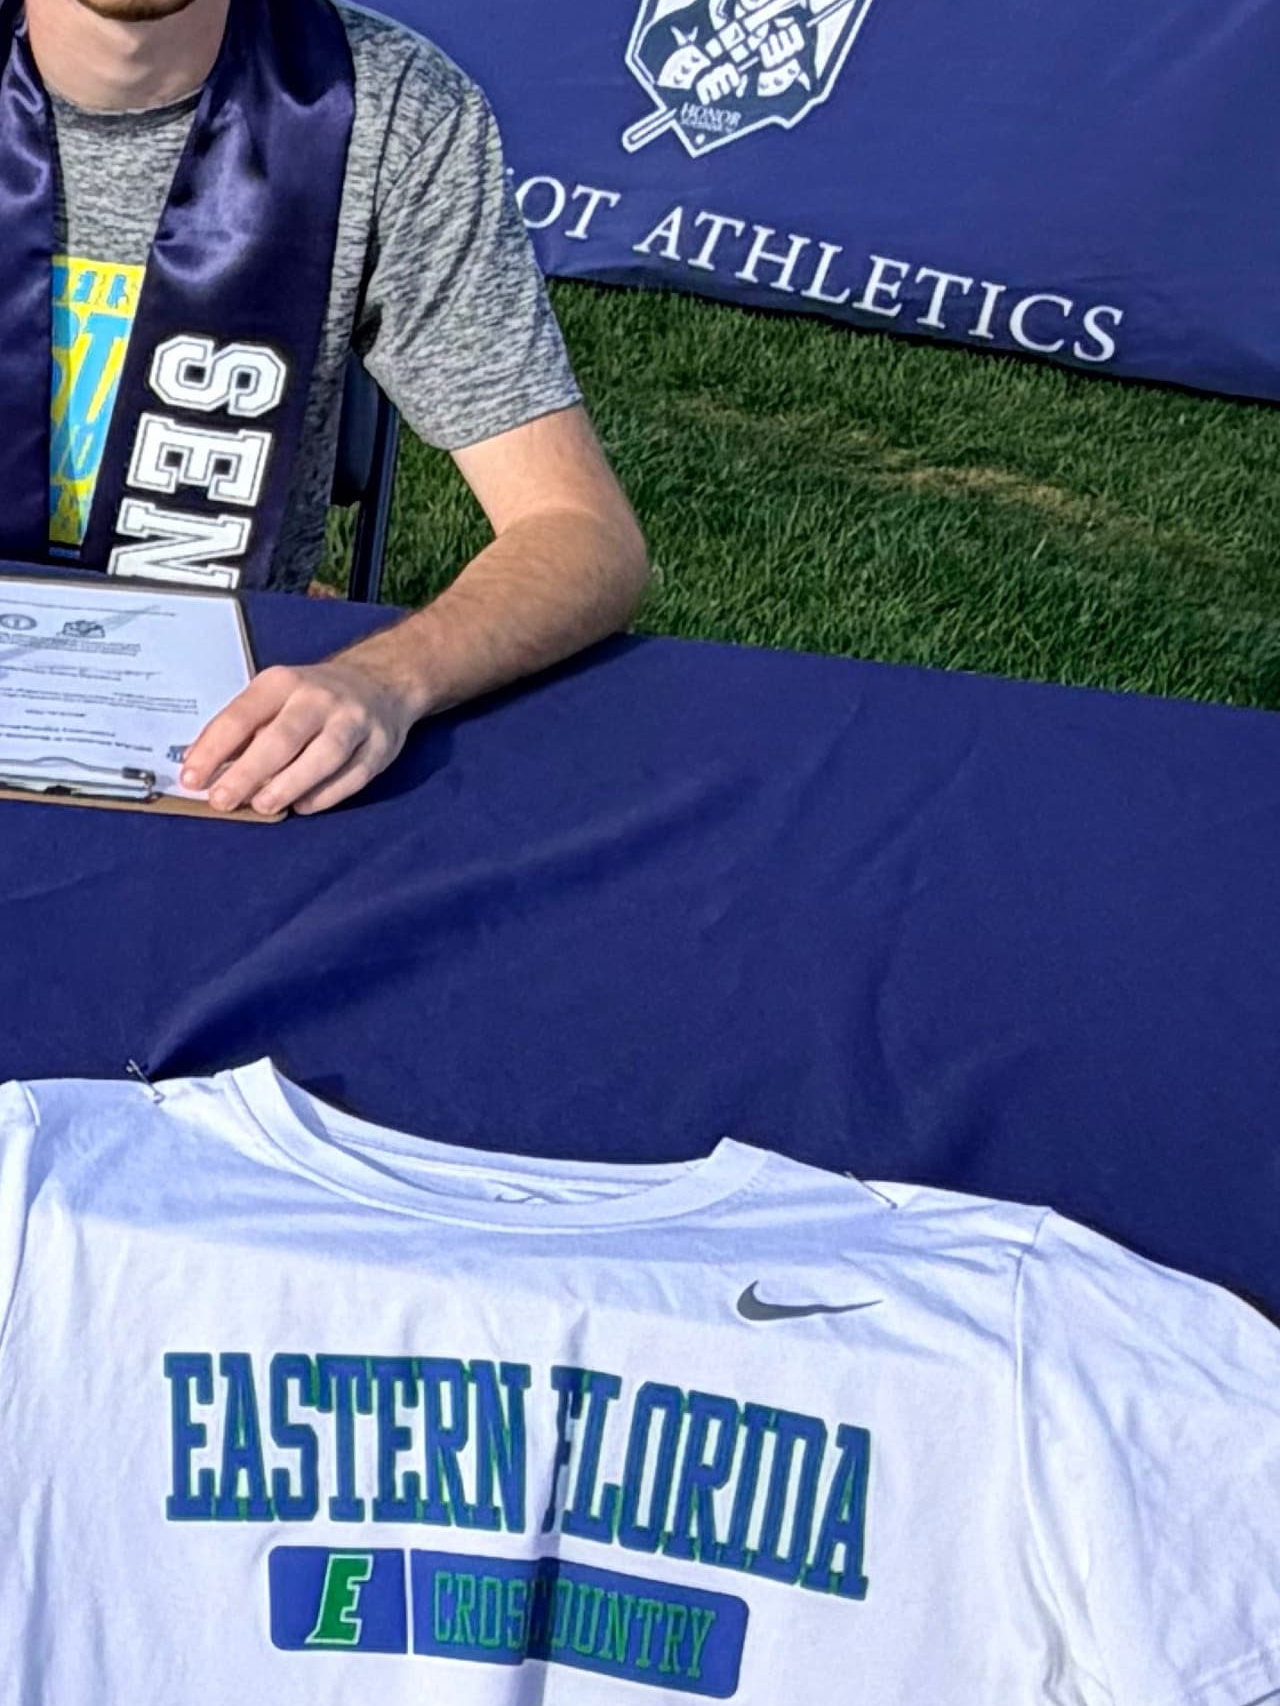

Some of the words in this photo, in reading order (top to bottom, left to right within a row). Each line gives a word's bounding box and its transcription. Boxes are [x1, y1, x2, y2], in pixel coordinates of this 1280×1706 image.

[633, 204, 1123, 361] ATHLETICS
[106, 334, 287, 589] SEN
[163, 1351, 531, 1533] EASTERN
[541, 1364, 872, 1600] FLORIDA
[304, 1553, 373, 1645] E
[433, 1571, 531, 1653] CROS
